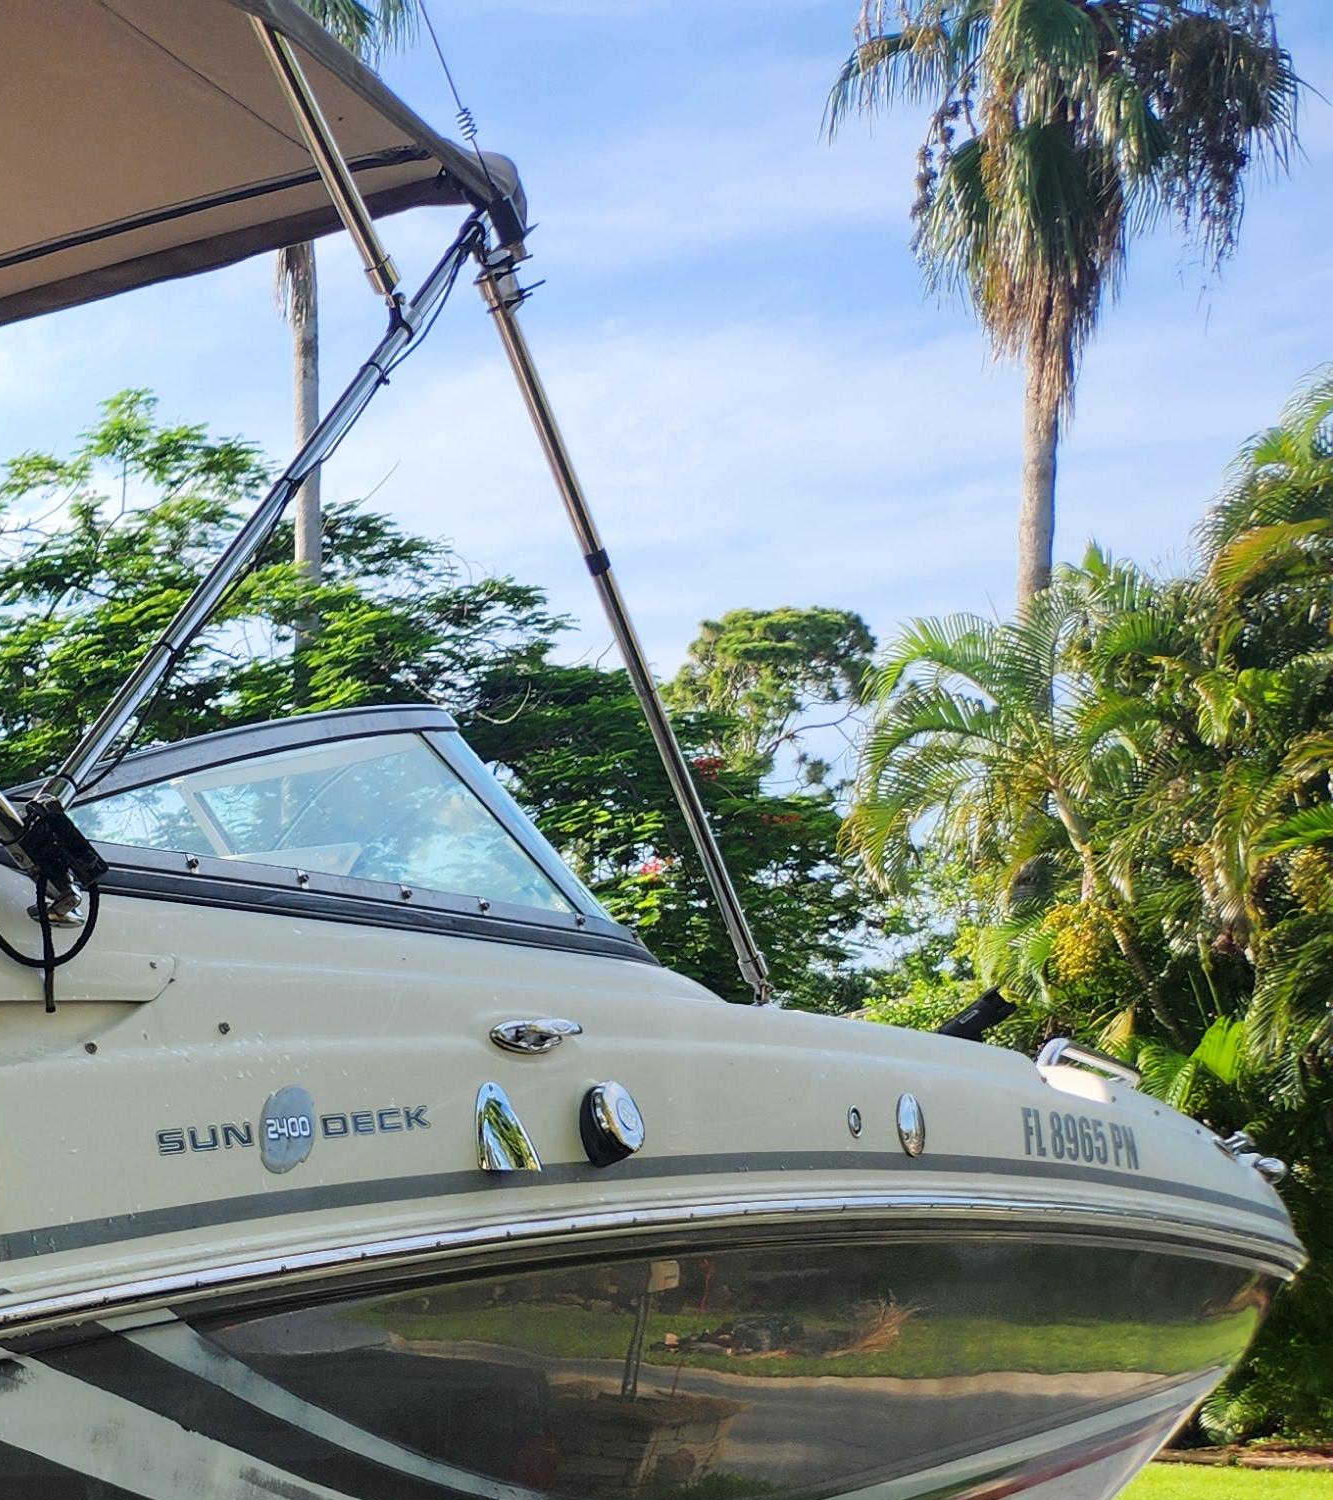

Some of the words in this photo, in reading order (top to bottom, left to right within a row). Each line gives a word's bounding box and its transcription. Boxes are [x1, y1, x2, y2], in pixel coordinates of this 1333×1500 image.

[155, 1121, 254, 1156] SUN
[265, 1115, 312, 1140] 2400
[319, 1105, 432, 1139] DECK
[1020, 1106, 1046, 1157] FL
[1049, 1110, 1108, 1165] 8965
[1108, 1121, 1139, 1171] PN
